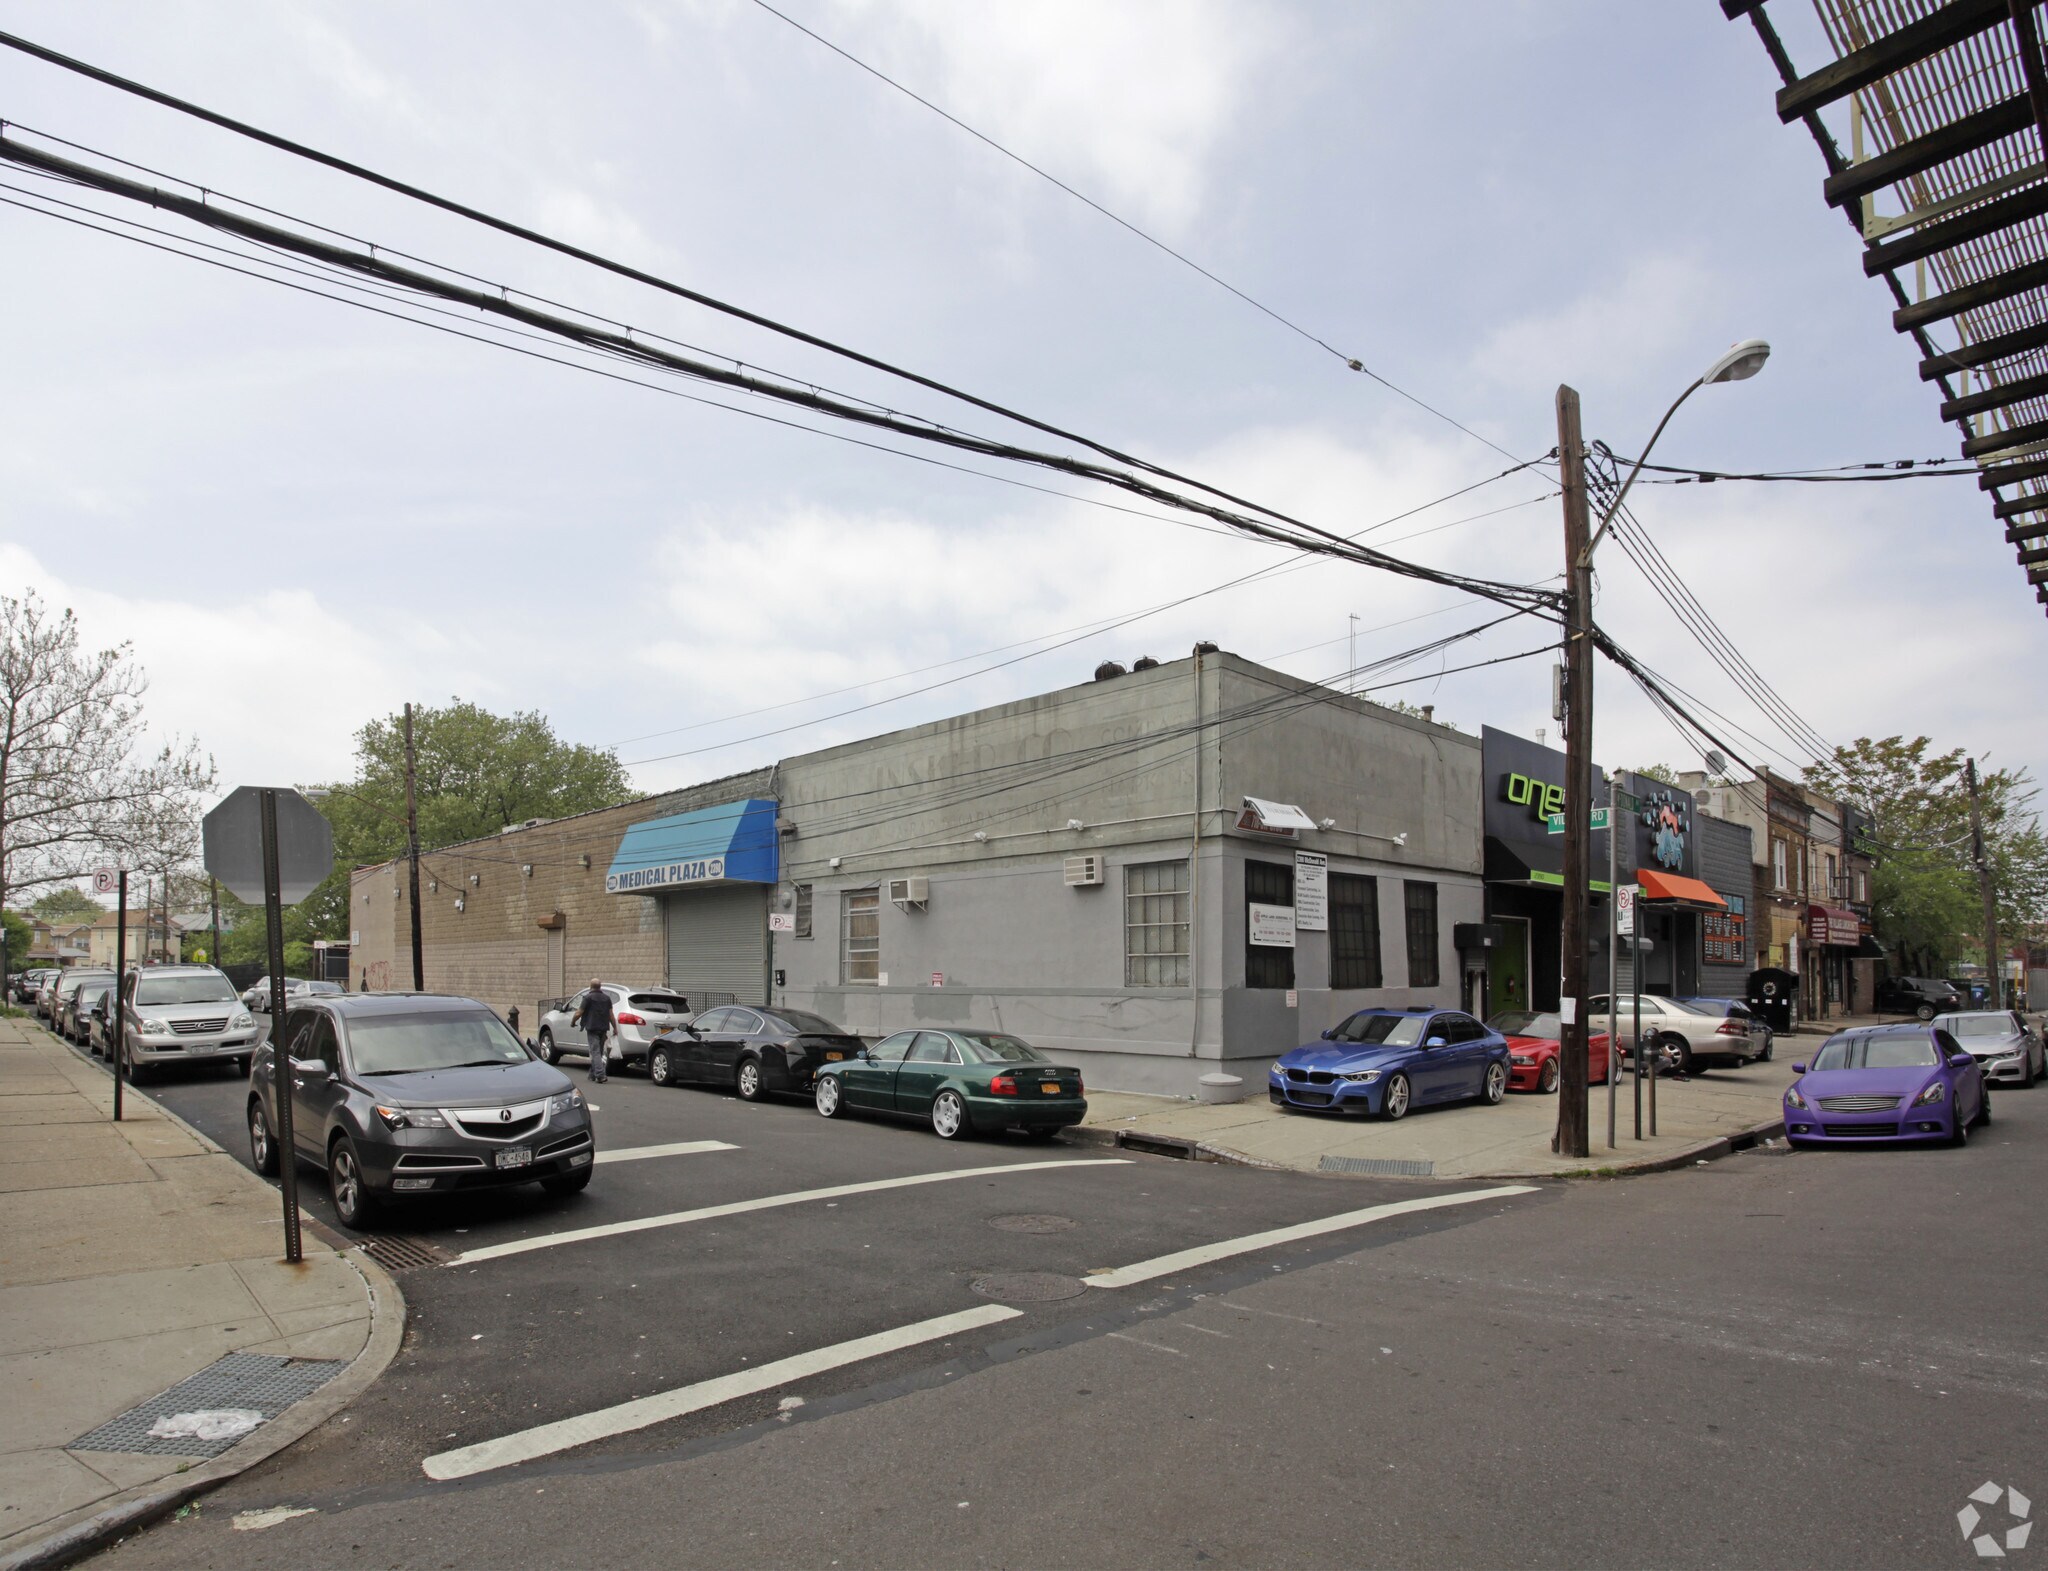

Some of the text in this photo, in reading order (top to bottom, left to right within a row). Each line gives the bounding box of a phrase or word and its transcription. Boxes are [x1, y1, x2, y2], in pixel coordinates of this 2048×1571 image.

[1591, 810, 1604, 821] RD
[619, 861, 706, 889] MEDICAL PLAZA
